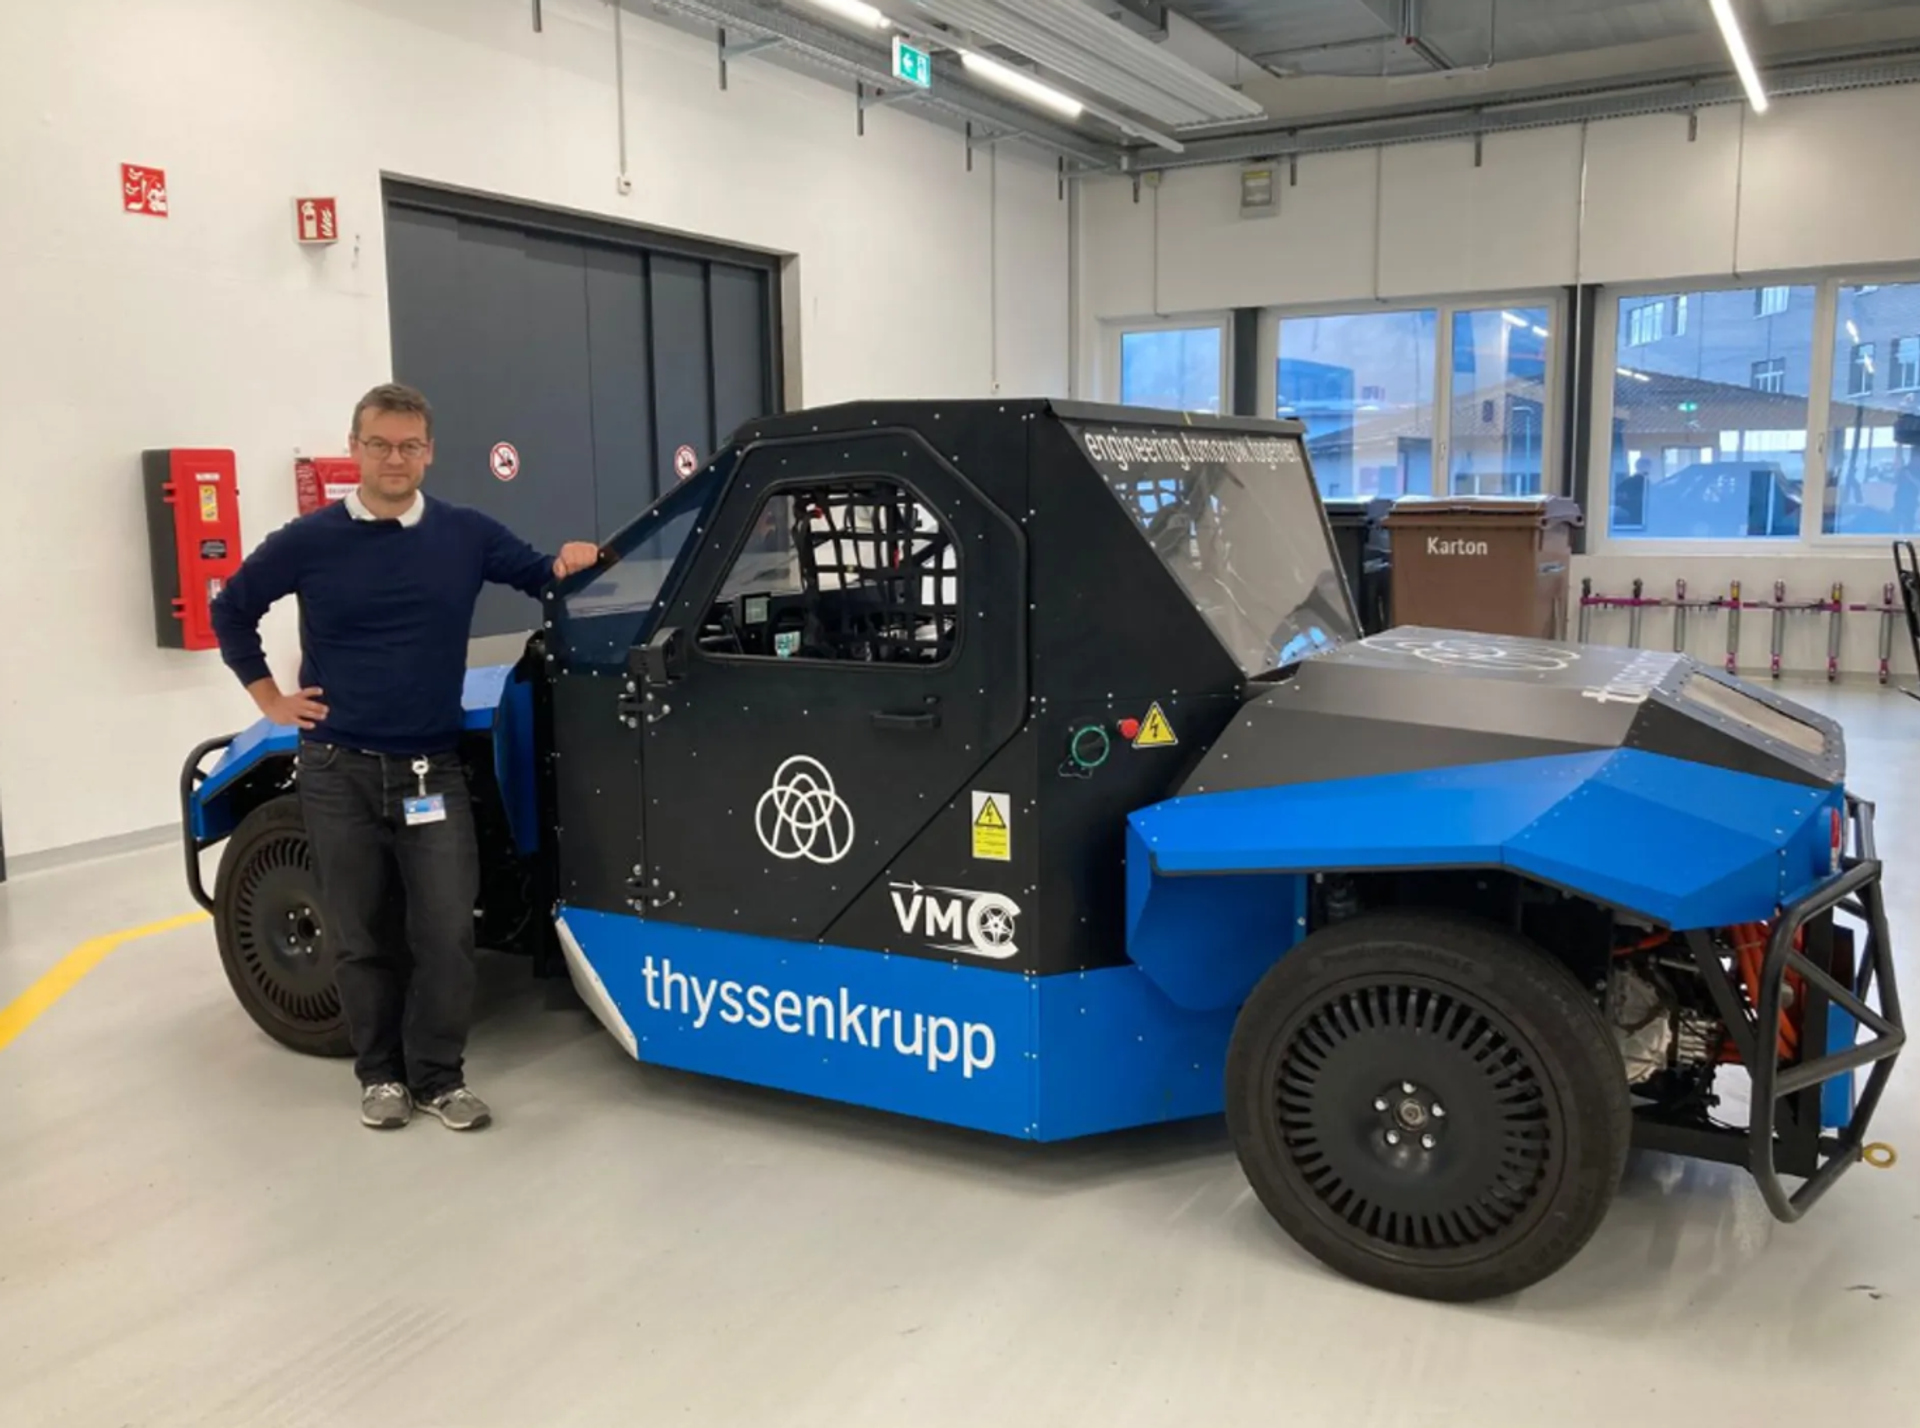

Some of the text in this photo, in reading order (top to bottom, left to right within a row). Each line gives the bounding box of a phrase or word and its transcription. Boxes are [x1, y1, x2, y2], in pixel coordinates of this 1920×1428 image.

[1427, 536, 1488, 555] Karton
[890, 890, 1021, 959] VMC
[641, 956, 996, 1079] thyssenkrupp
